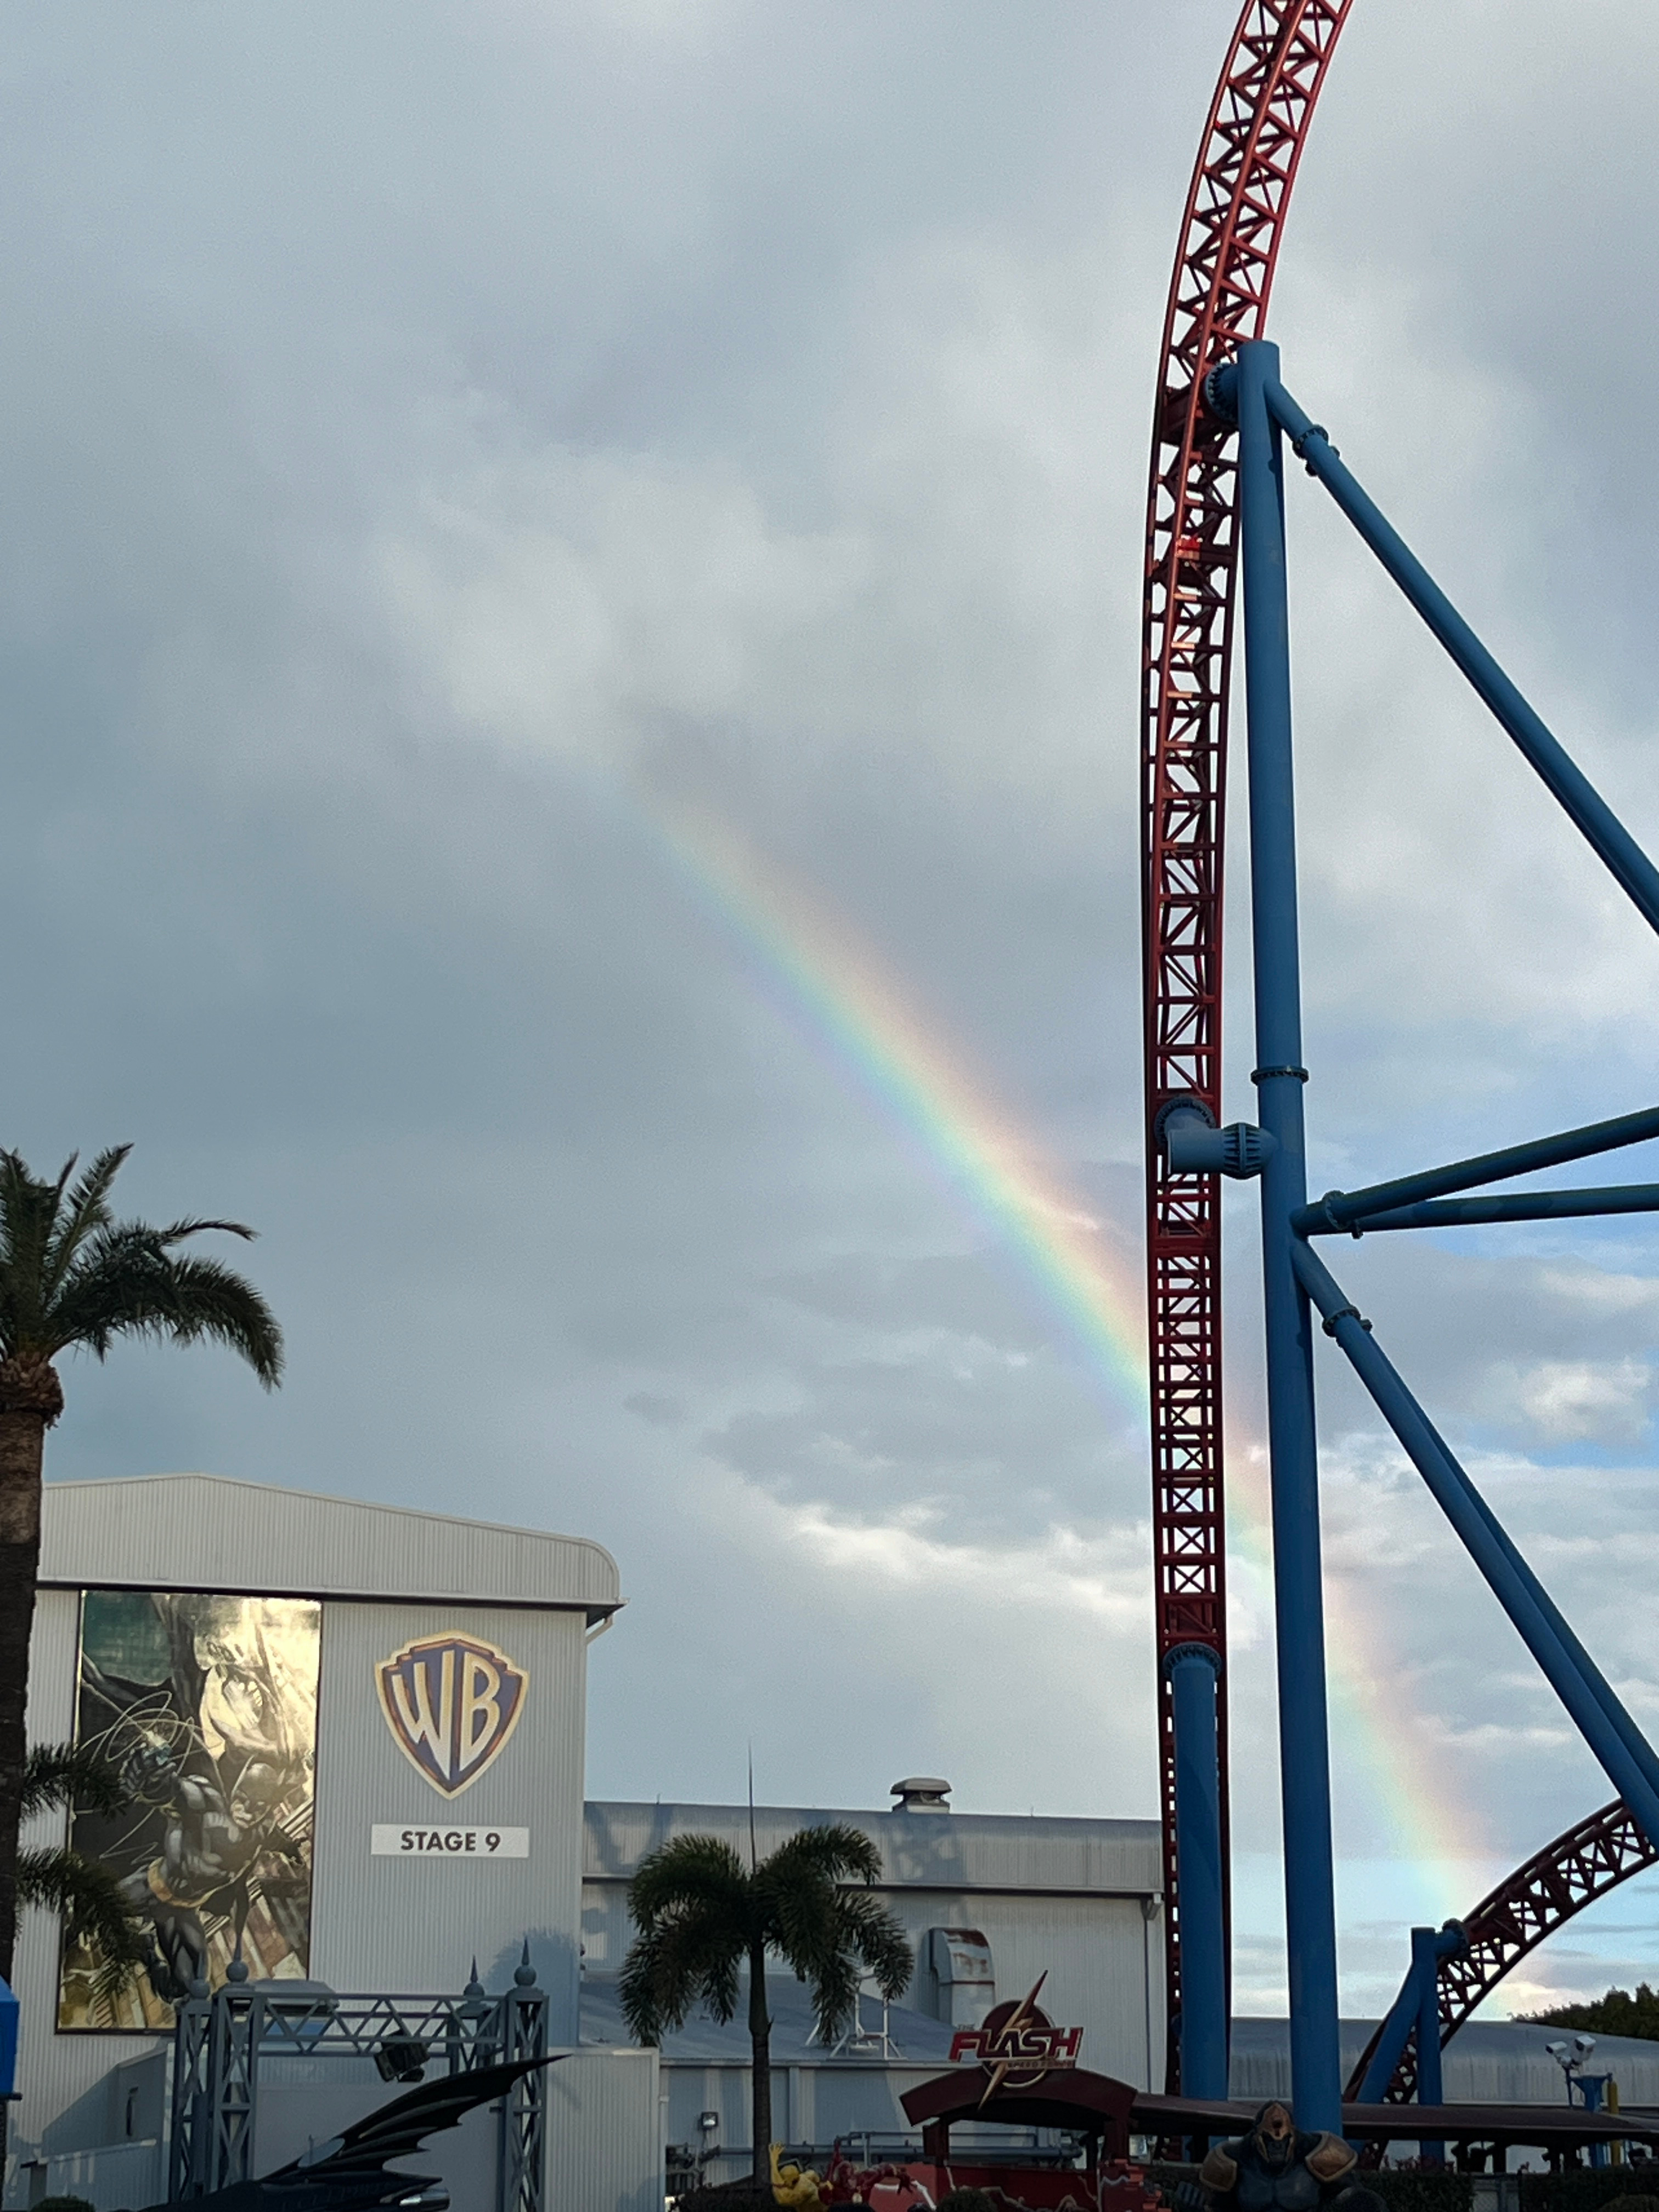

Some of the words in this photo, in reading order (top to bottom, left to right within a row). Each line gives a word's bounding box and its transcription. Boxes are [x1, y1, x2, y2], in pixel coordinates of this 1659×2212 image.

[392, 1650, 500, 1781] WB
[401, 1831, 476, 1852] STAGE
[486, 1832, 501, 1852] 9
[949, 2027, 1083, 2062] FLASH
